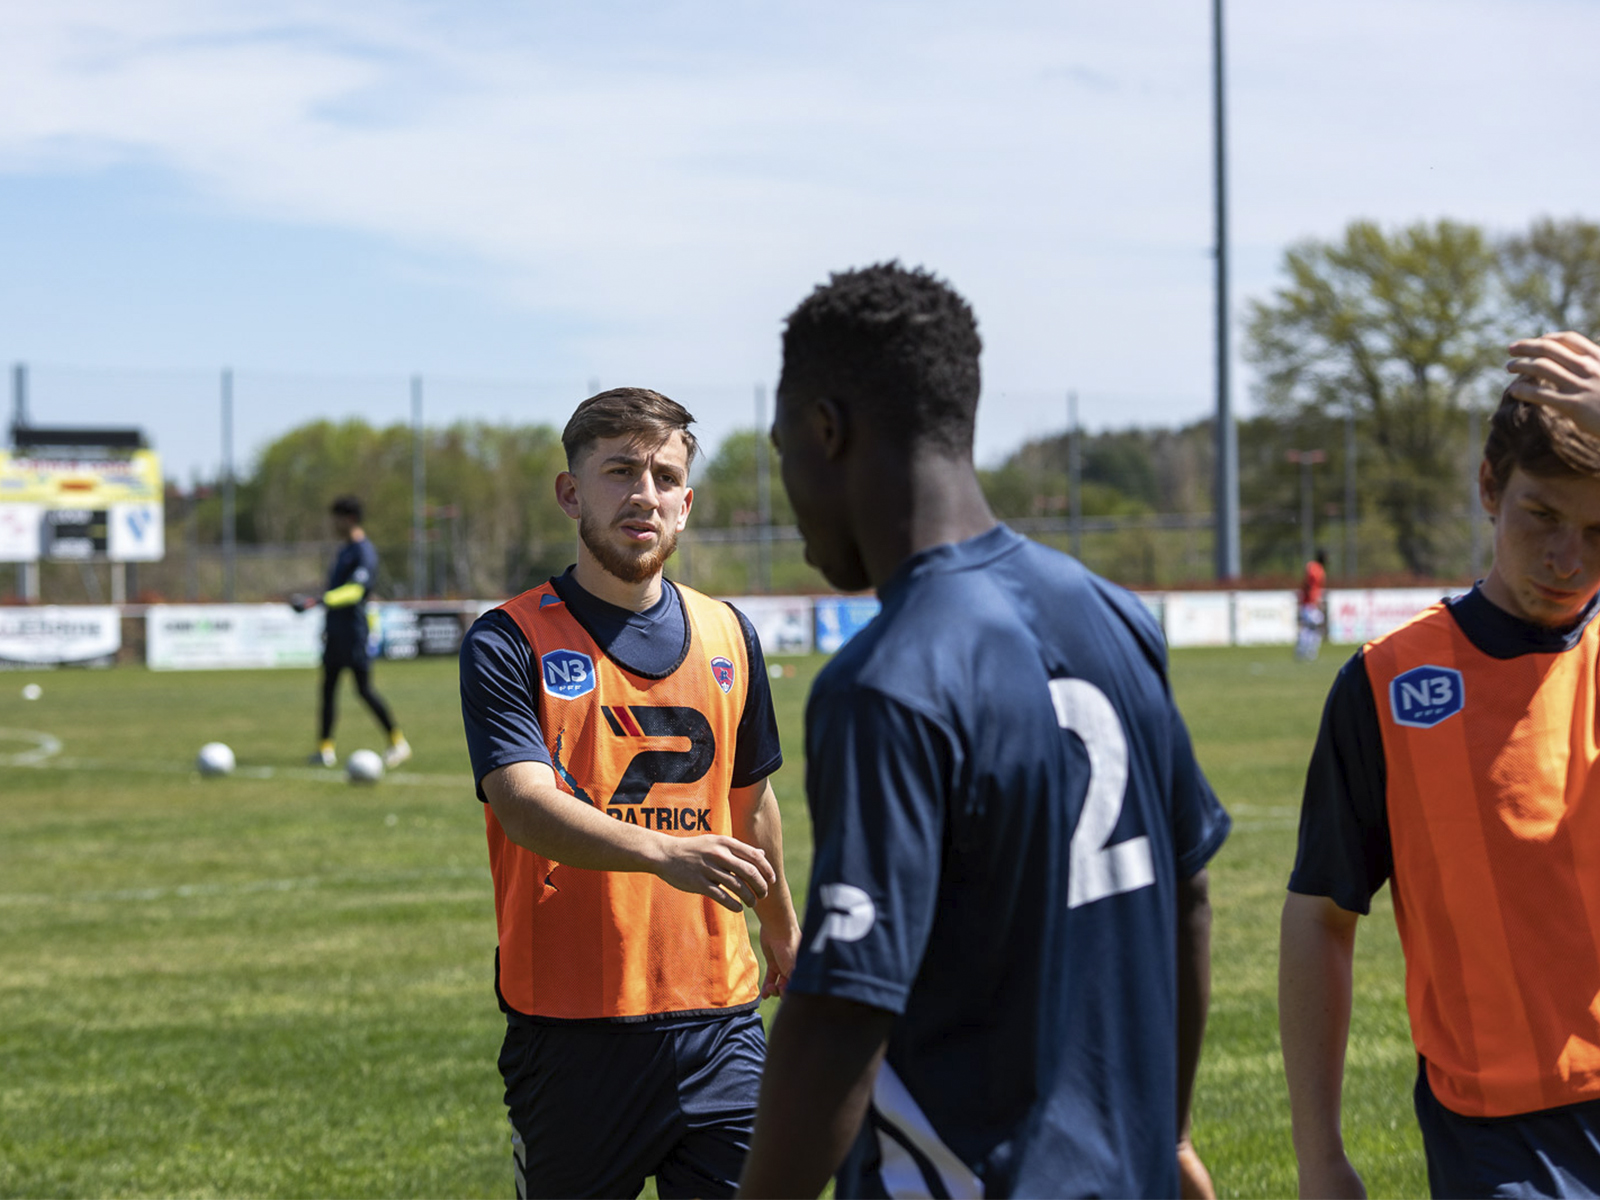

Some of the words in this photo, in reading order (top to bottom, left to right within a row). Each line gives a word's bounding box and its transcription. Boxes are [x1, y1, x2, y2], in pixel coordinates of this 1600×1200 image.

[546, 659, 587, 684] N3
[1400, 676, 1453, 710] N3
[1048, 678, 1155, 909] 2
